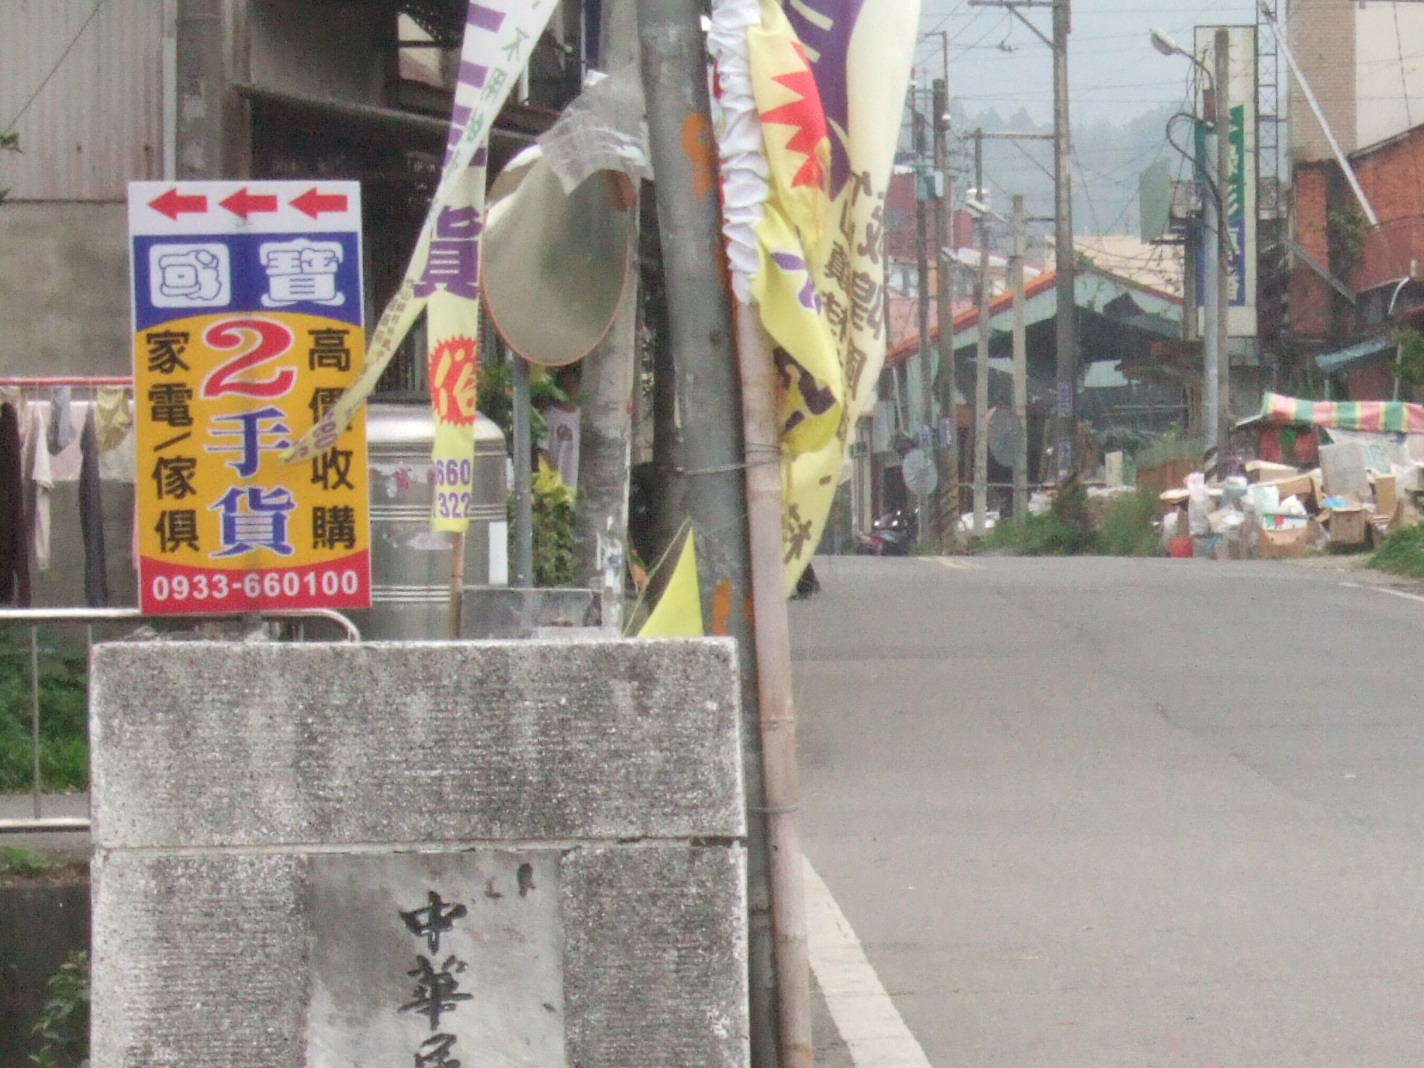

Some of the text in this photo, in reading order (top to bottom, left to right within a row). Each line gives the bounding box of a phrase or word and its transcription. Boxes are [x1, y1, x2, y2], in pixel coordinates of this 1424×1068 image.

[149, 238, 344, 308] 國寶
[201, 316, 297, 557] 2手貨
[152, 569, 360, 602] 0933-660100
